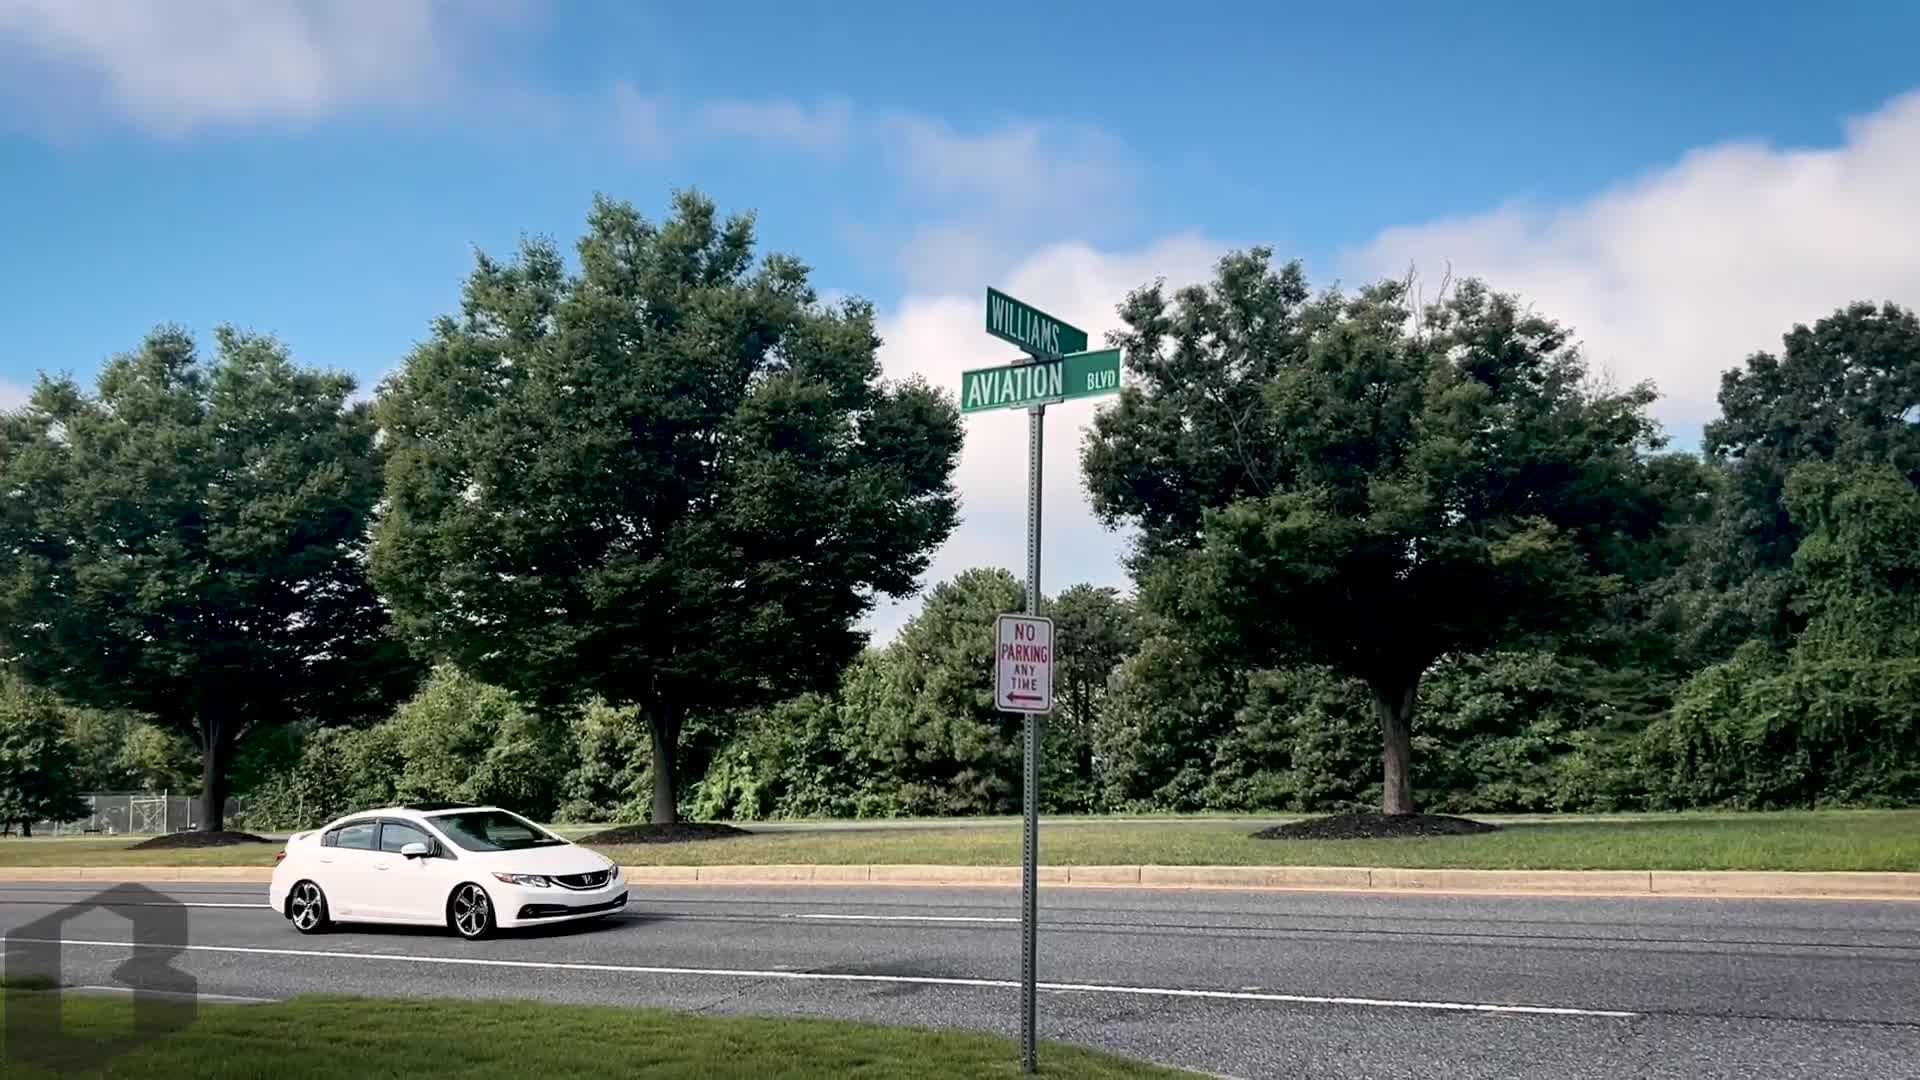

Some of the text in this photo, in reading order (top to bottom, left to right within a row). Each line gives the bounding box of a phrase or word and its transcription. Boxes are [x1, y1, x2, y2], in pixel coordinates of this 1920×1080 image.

[992, 295, 1060, 353] WILLIAMS
[967, 361, 1115, 407] AVIATION BLVD
[1015, 623, 1035, 641] NO
[1001, 643, 1048, 663] PARKING
[1014, 664, 1036, 676] ANY
[1011, 677, 1037, 691] TIME
